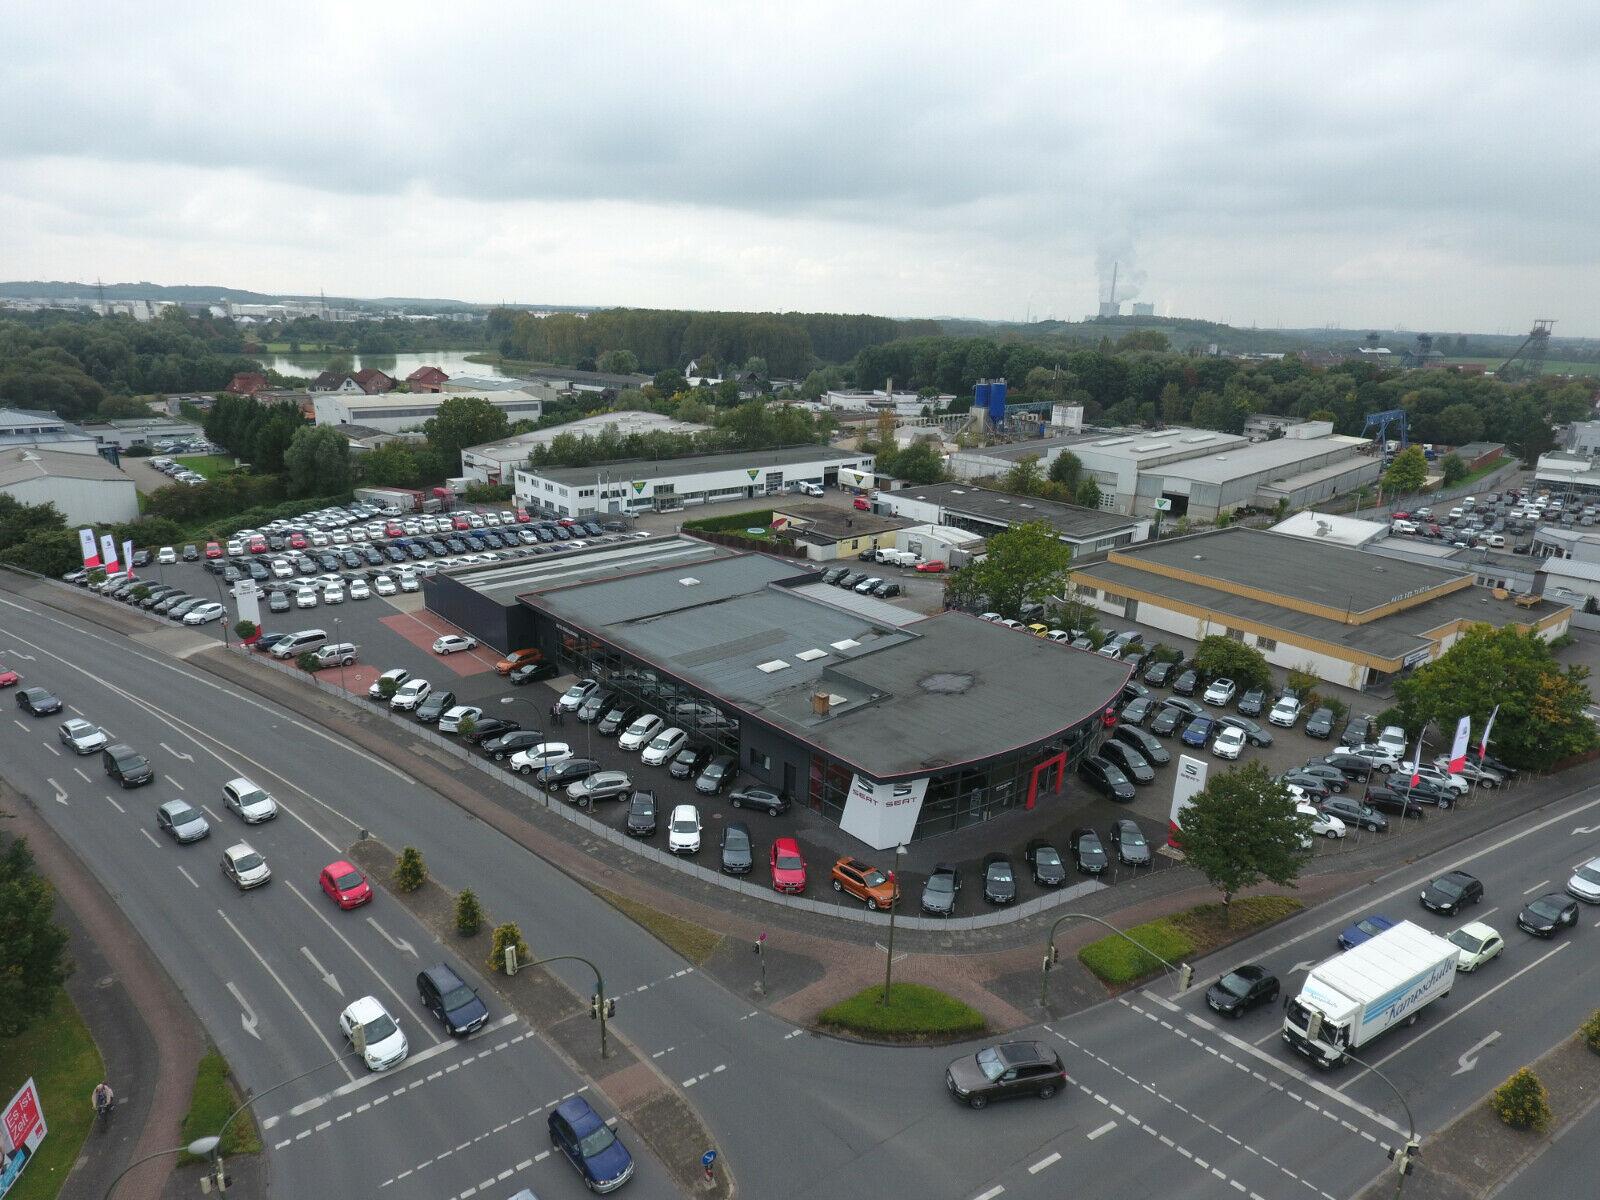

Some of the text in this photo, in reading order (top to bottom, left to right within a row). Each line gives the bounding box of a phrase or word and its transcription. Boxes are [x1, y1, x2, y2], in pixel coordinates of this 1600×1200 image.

[852, 788, 879, 806] SEAT
[885, 796, 918, 808] SEAT
[1385, 958, 1455, 1026] Kampschulte
[6, 1110, 20, 1129] Es
[11, 1113, 29, 1141] Zeit
